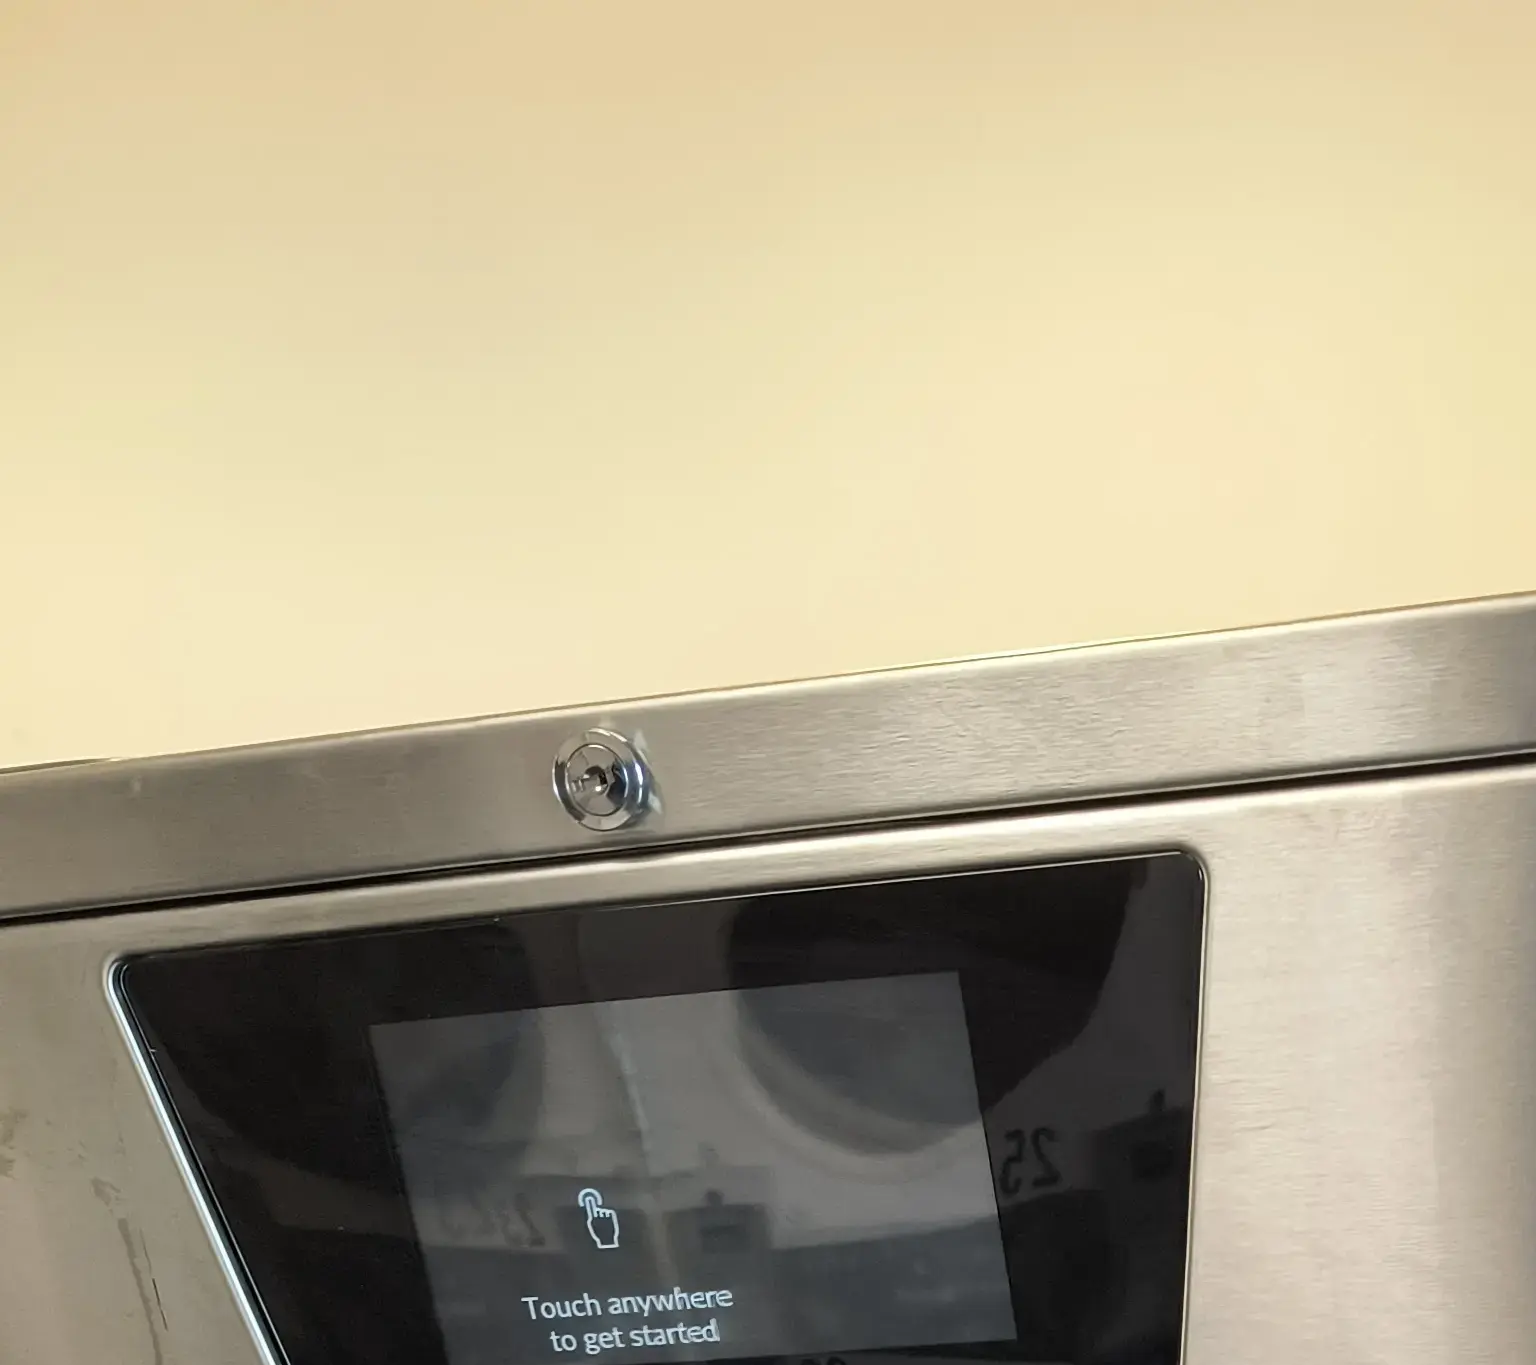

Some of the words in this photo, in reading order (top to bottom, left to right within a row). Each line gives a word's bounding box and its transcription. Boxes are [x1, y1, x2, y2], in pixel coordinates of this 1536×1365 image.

[520, 1292, 603, 1320] Touch
[607, 1286, 734, 1317] anywhere
[549, 1330, 578, 1352] to
[583, 1326, 626, 1355] get
[628, 1317, 721, 1347] started
